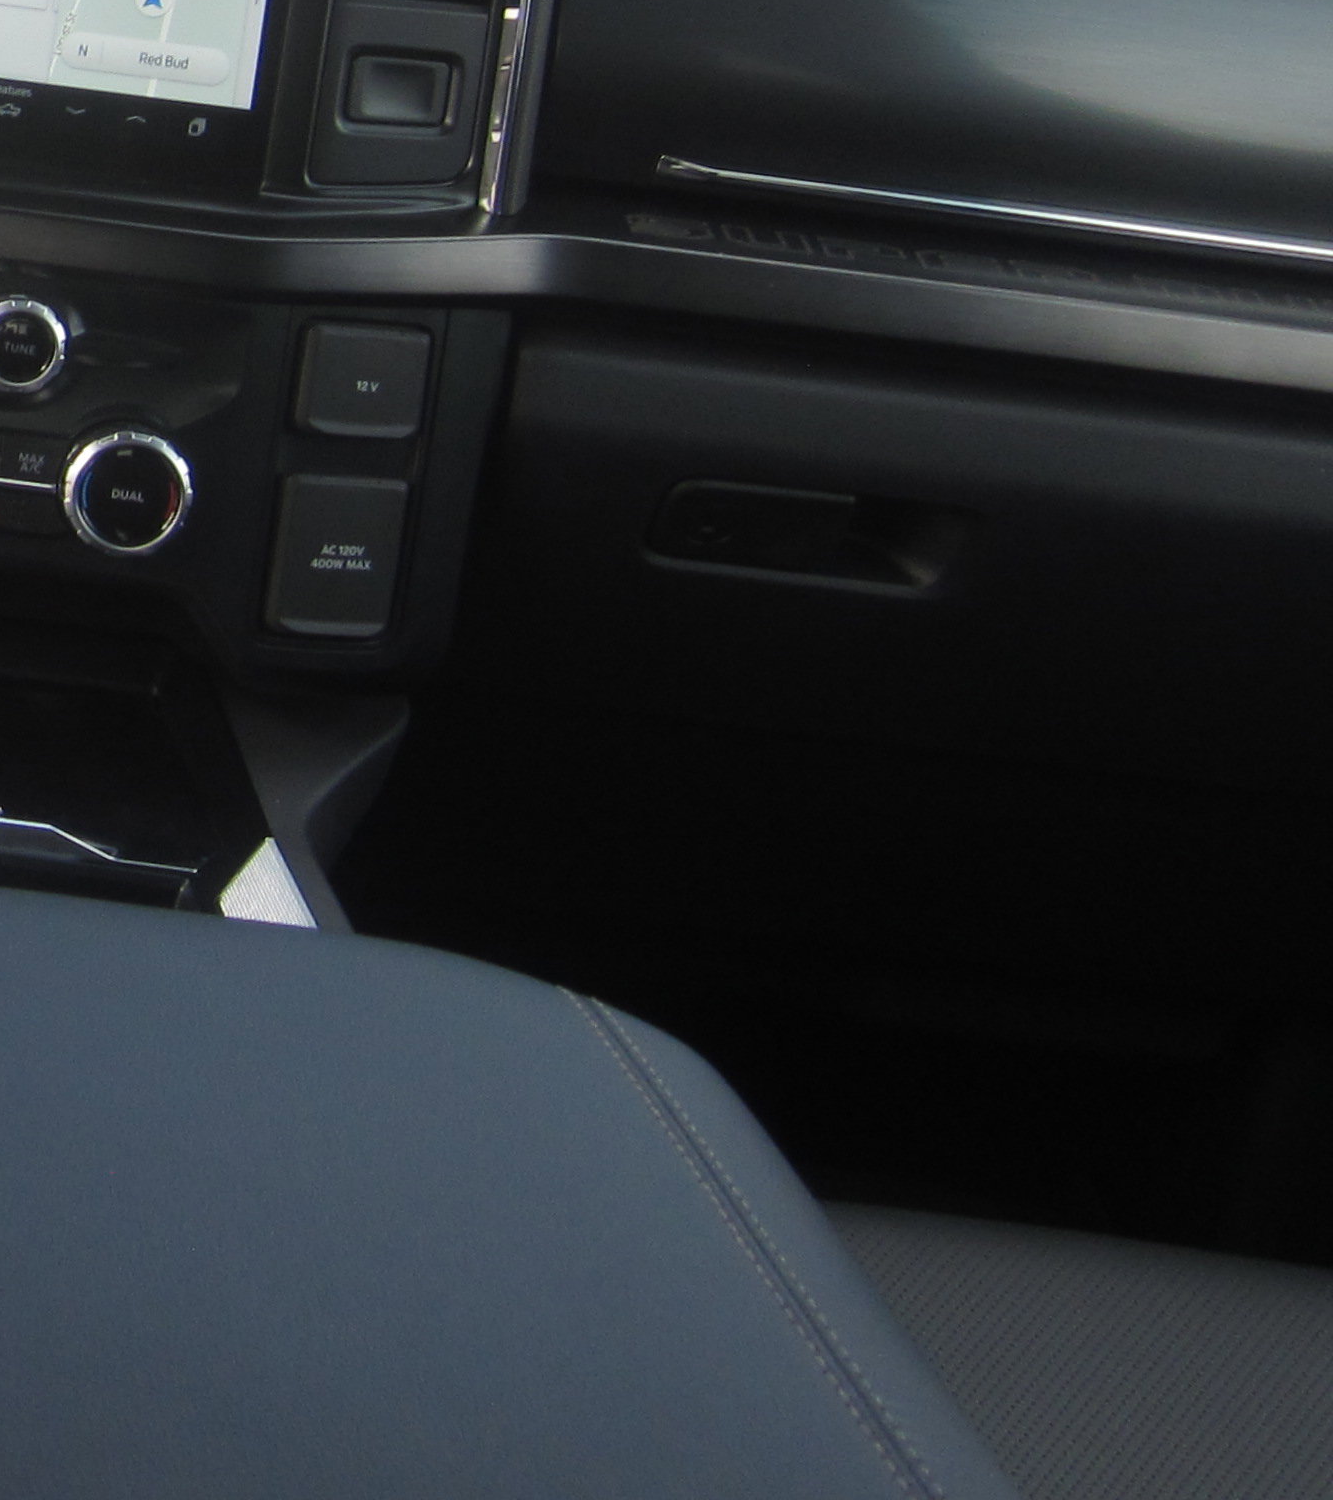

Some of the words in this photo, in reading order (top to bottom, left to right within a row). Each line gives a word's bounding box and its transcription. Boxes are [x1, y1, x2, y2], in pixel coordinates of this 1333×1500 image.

[77, 44, 89, 57] N
[138, 52, 163, 68] Red
[164, 55, 190, 71] Bud
[4, 341, 37, 356] TUNE
[355, 380, 369, 392] 12
[369, 382, 380, 392] V
[18, 452, 45, 465] MAX
[110, 487, 145, 503] DUAL
[321, 544, 337, 556] AC
[337, 545, 365, 557] 120V
[309, 557, 344, 570] 400W
[346, 559, 372, 571] MAX
